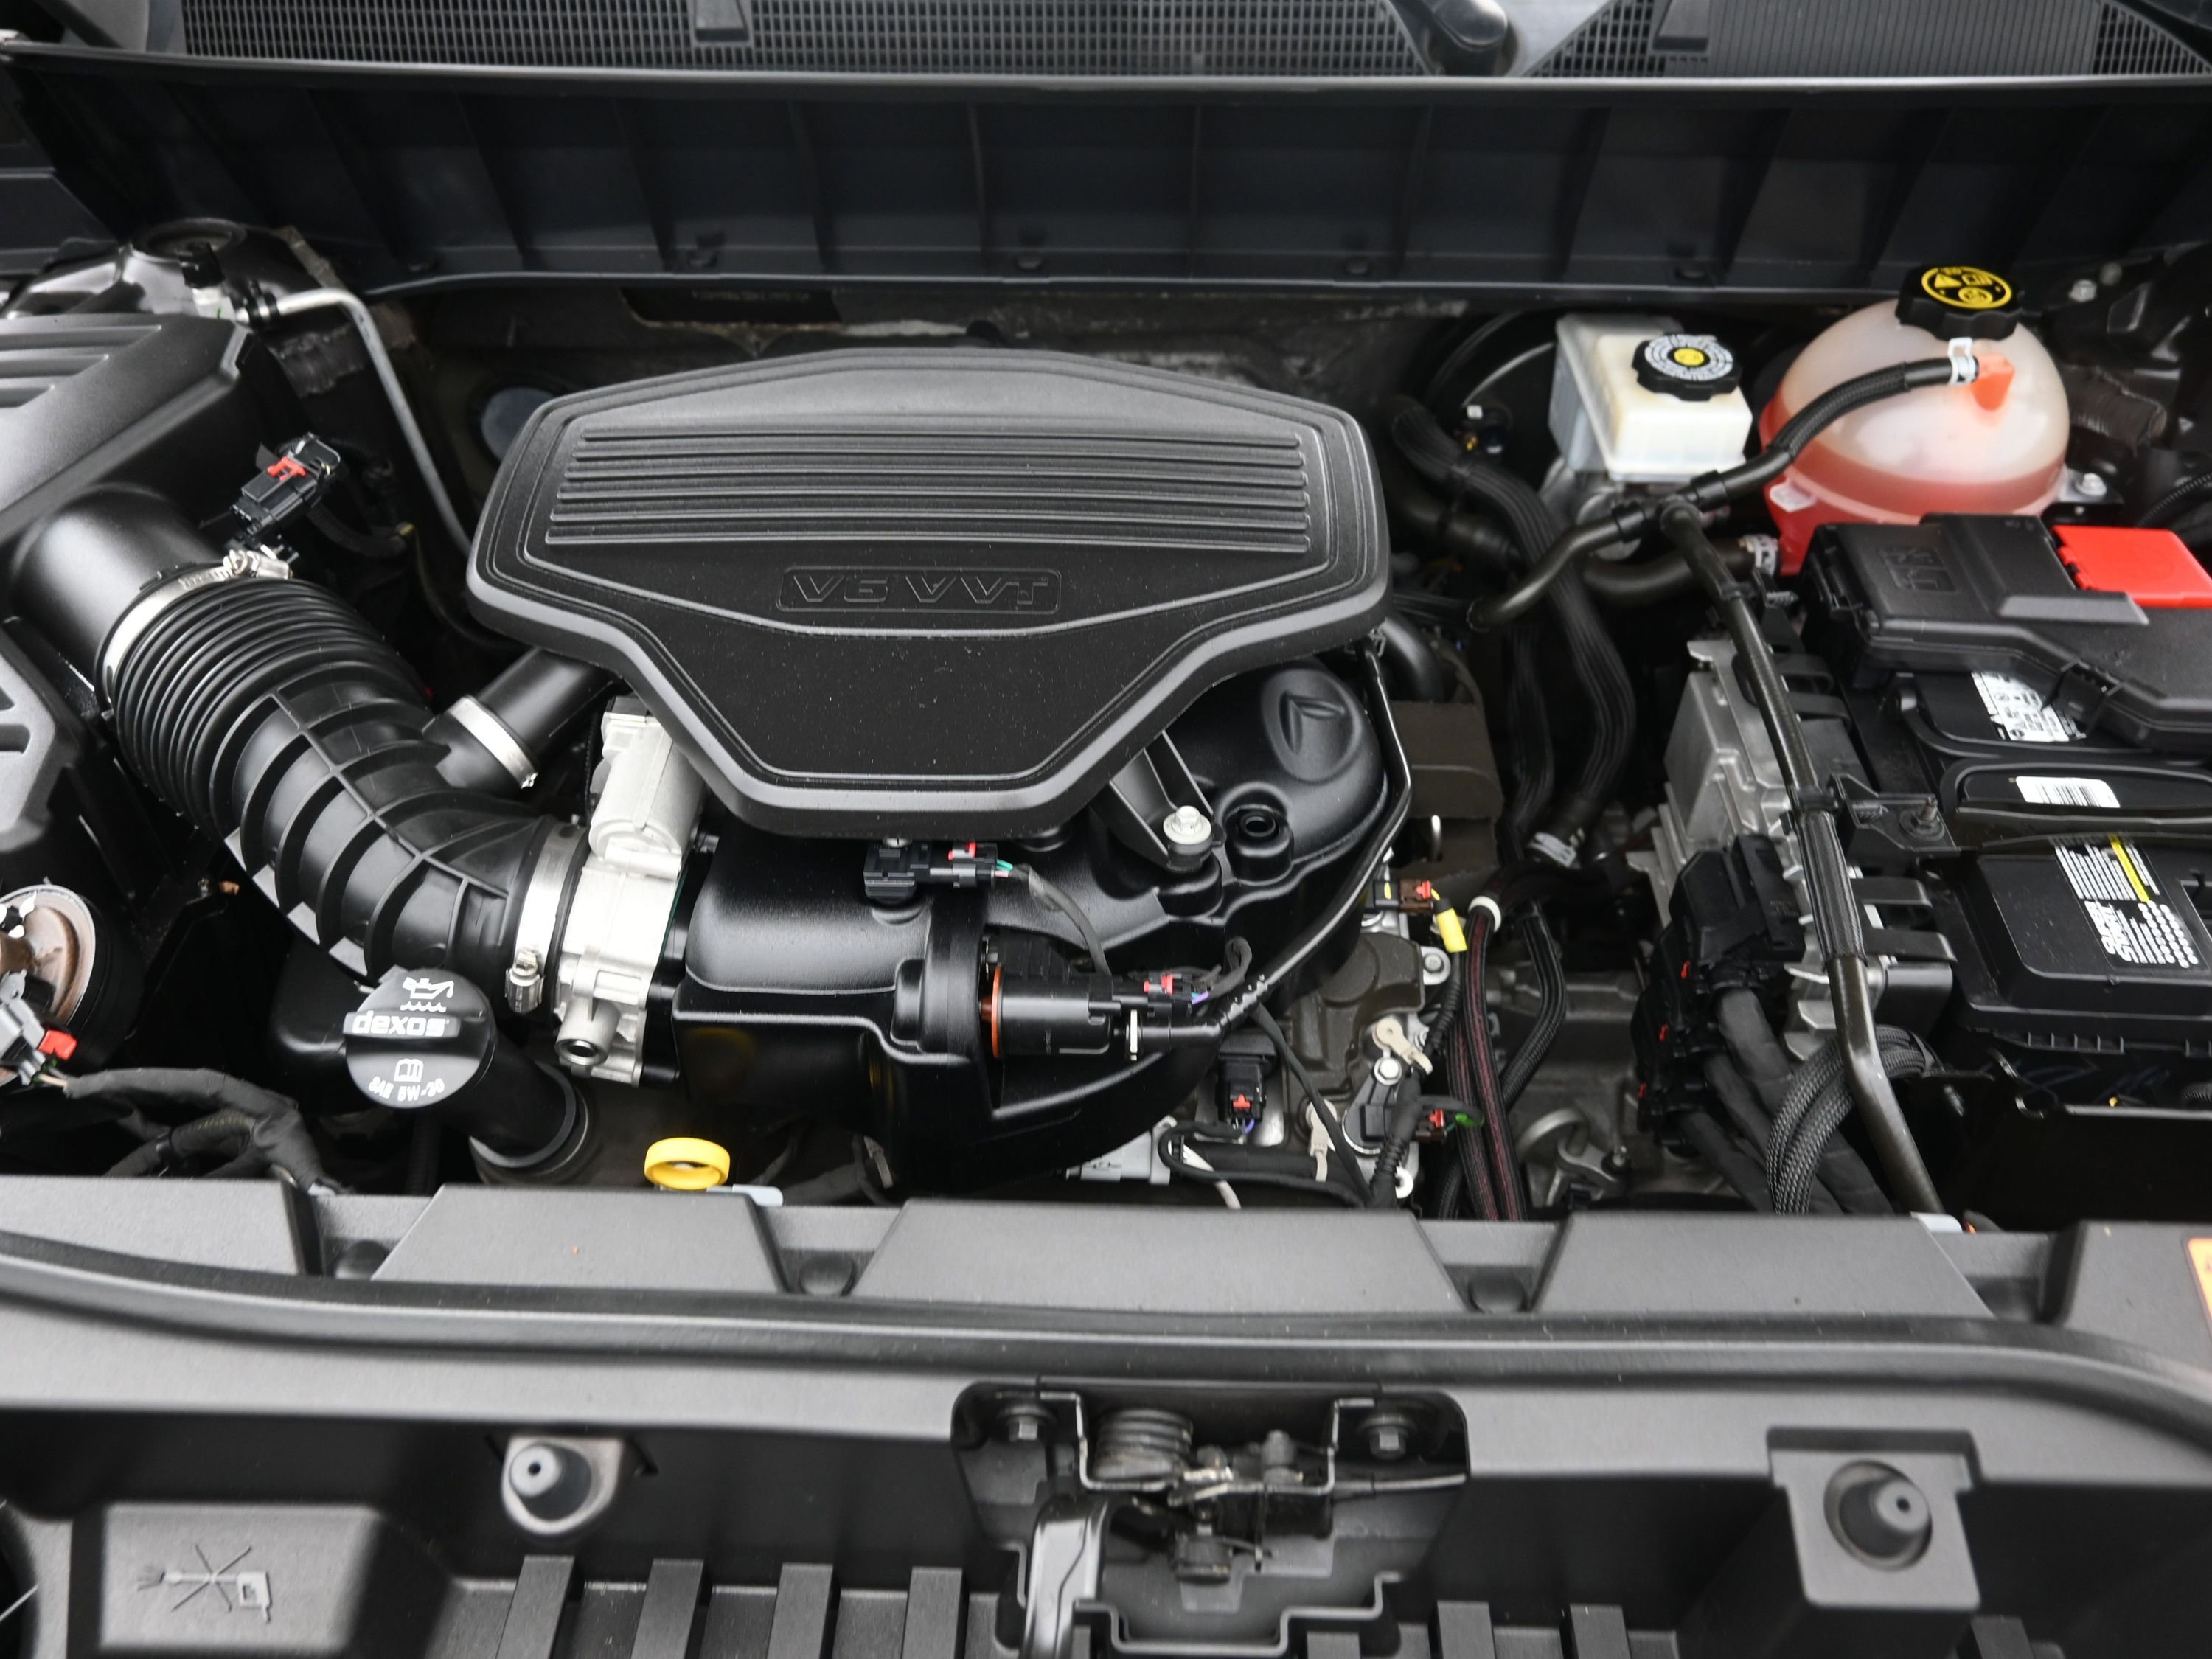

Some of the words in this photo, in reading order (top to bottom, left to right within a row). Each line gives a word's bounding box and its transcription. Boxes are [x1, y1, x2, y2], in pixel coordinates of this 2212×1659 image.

[793, 574, 888, 603] V6
[905, 575, 1048, 605] VVT
[352, 1010, 447, 1037] dexos
[369, 1077, 394, 1099] SAE
